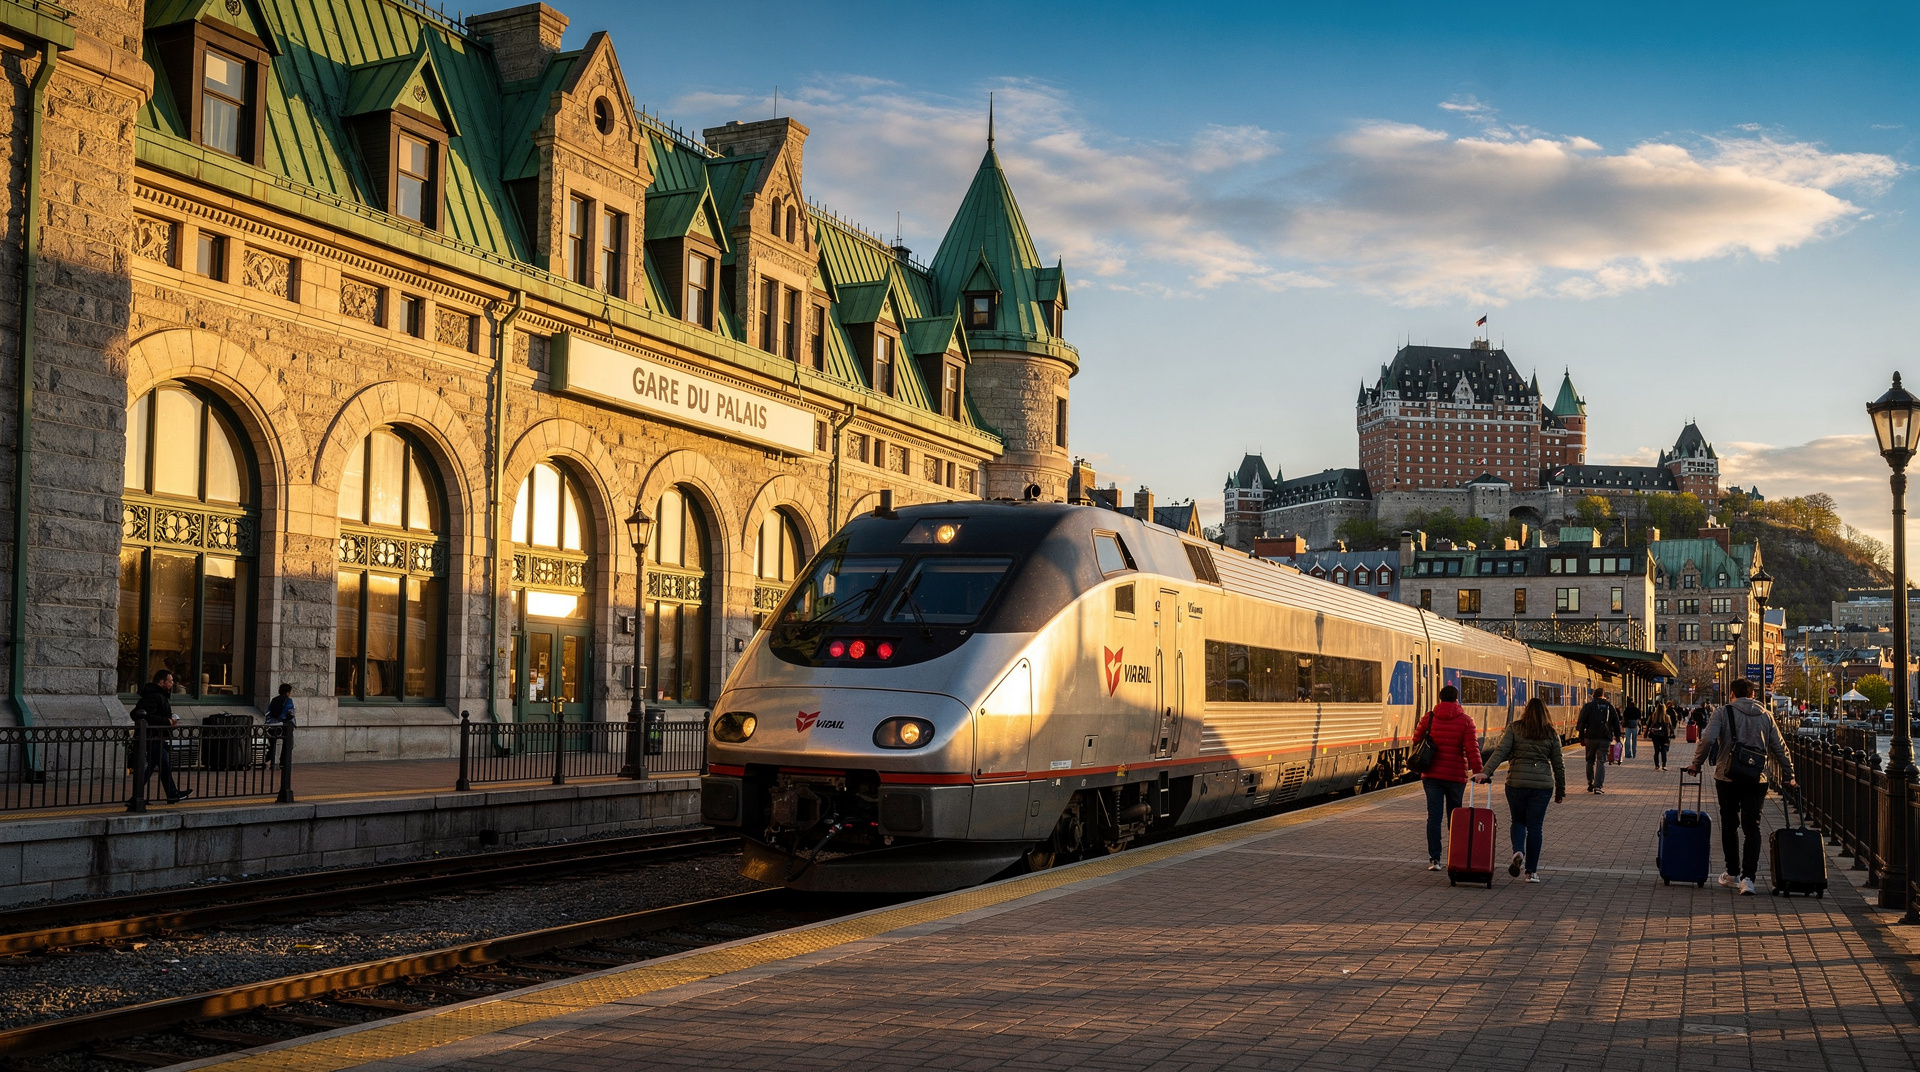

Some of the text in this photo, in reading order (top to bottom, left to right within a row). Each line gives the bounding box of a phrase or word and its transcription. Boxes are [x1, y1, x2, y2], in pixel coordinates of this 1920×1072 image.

[632, 366, 767, 430] GARE DU PALAIS
